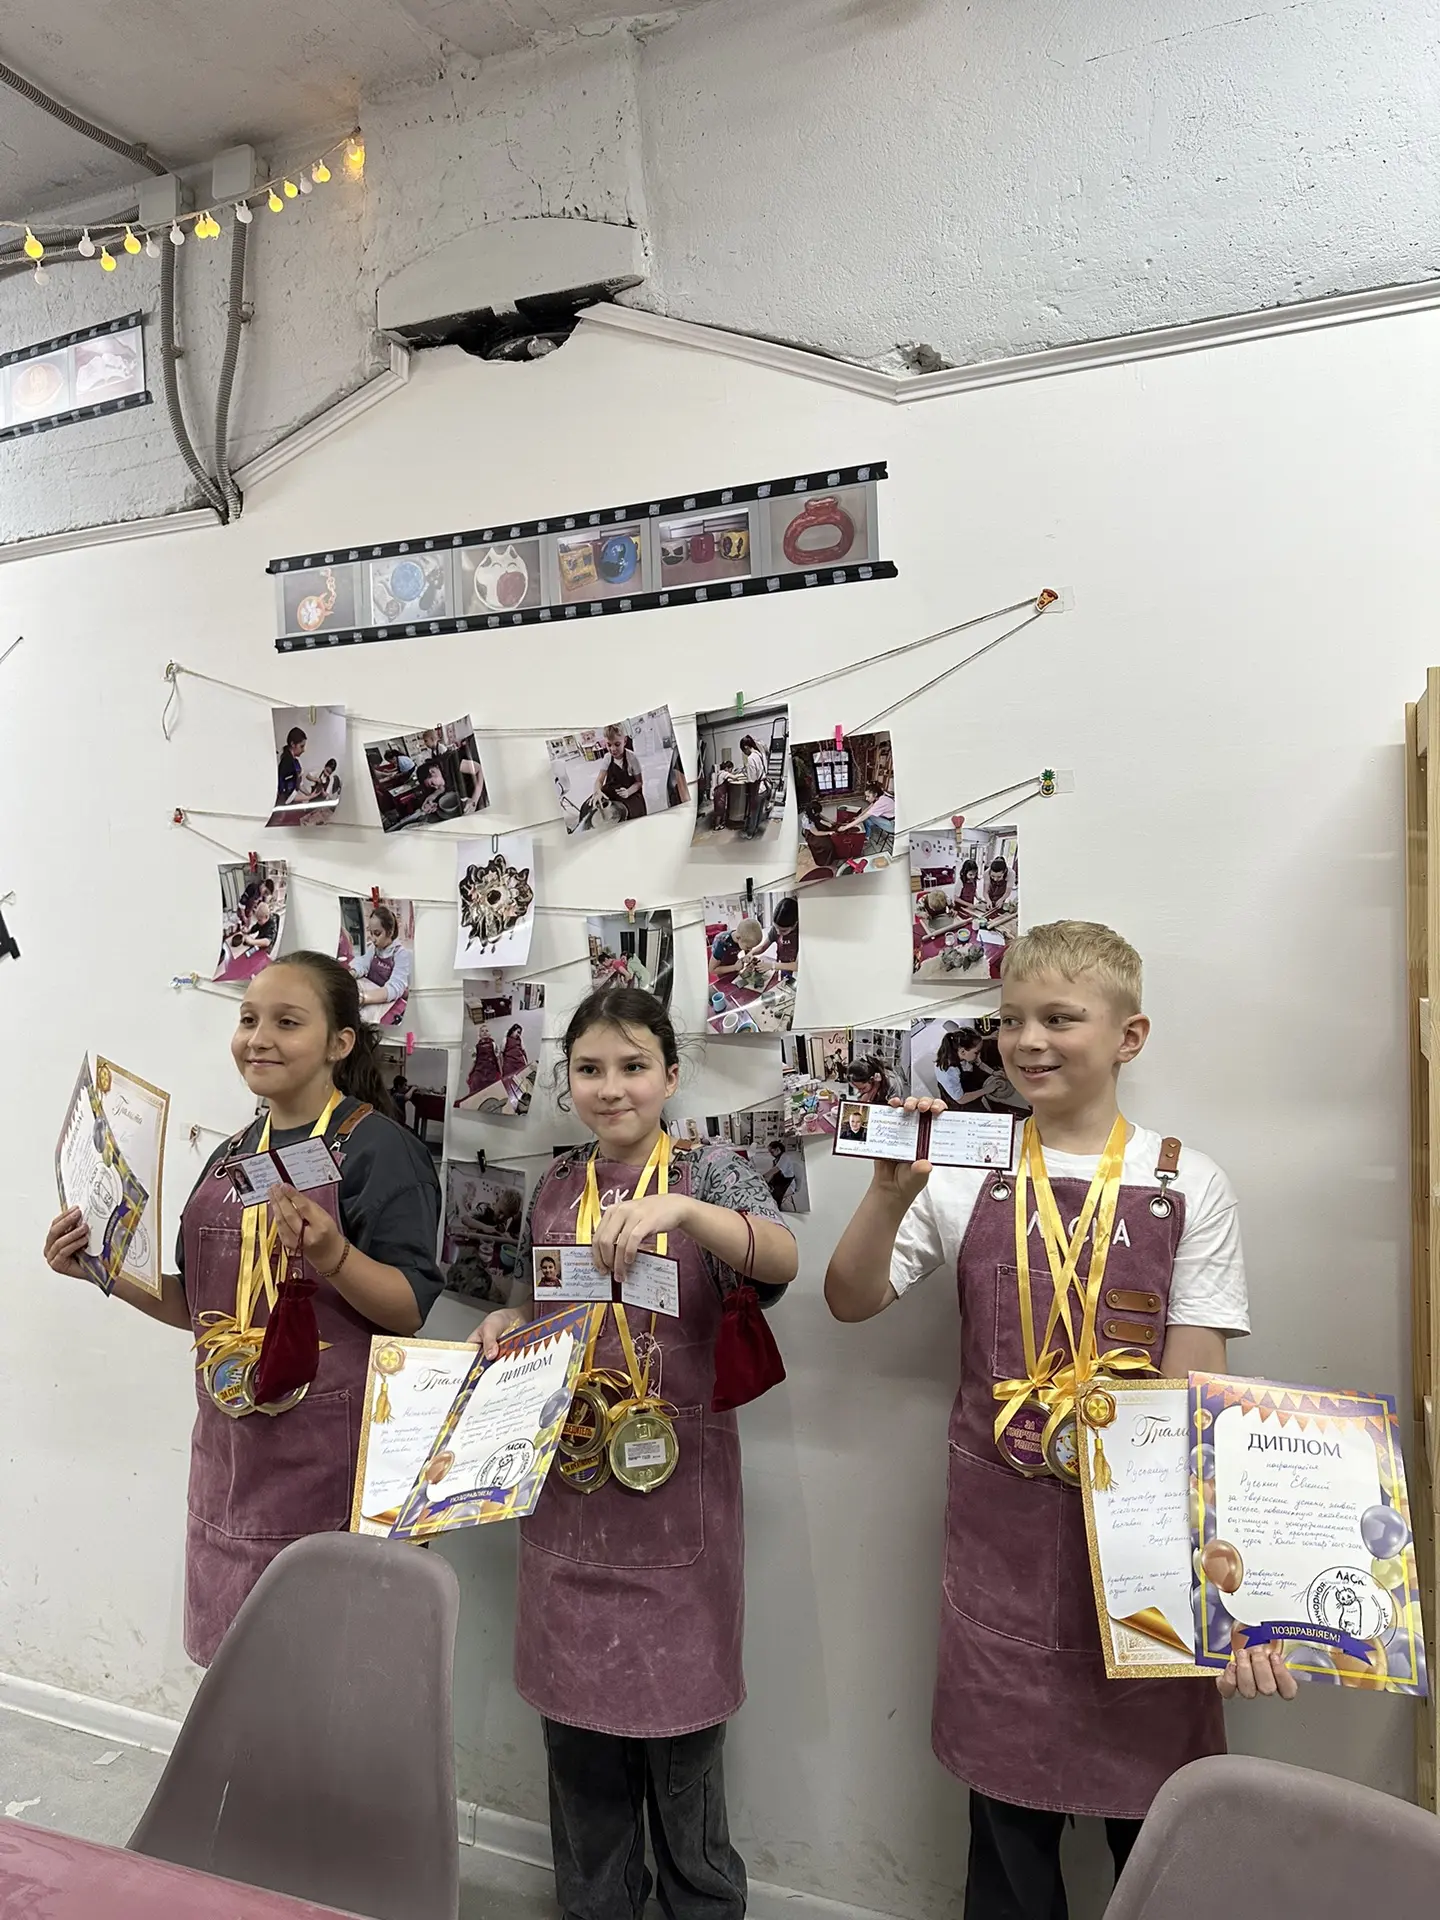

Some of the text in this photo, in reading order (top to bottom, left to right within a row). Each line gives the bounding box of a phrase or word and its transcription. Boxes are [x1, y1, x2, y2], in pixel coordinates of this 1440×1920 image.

[496, 1353, 553, 1385] ДИПЛОМ
[1131, 1413, 1190, 1448] Грам
[1248, 1433, 1342, 1459] ДИПЛОМ
[1271, 1626, 1341, 1643] ПОЗДРАВЛЯЕМ!
